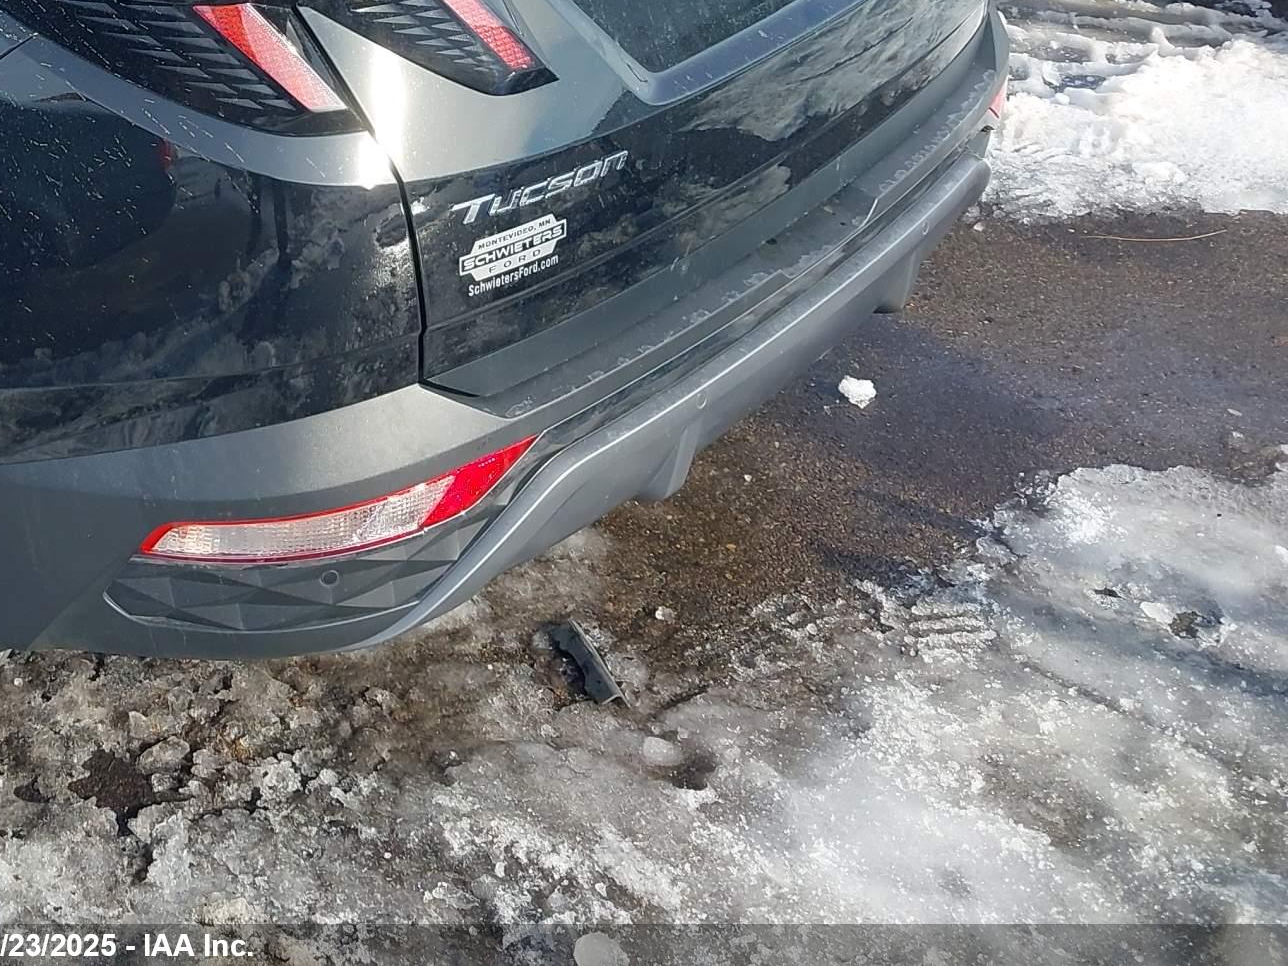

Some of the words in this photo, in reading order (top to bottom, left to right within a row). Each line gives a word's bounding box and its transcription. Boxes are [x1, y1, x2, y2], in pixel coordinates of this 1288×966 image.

[463, 224, 562, 271] SCHWIETERS
[478, 225, 537, 250] MONTEVIDEO,
[538, 218, 551, 228] MN
[468, 255, 559, 297] SchwietersFord.com
[488, 249, 541, 274] FORD
